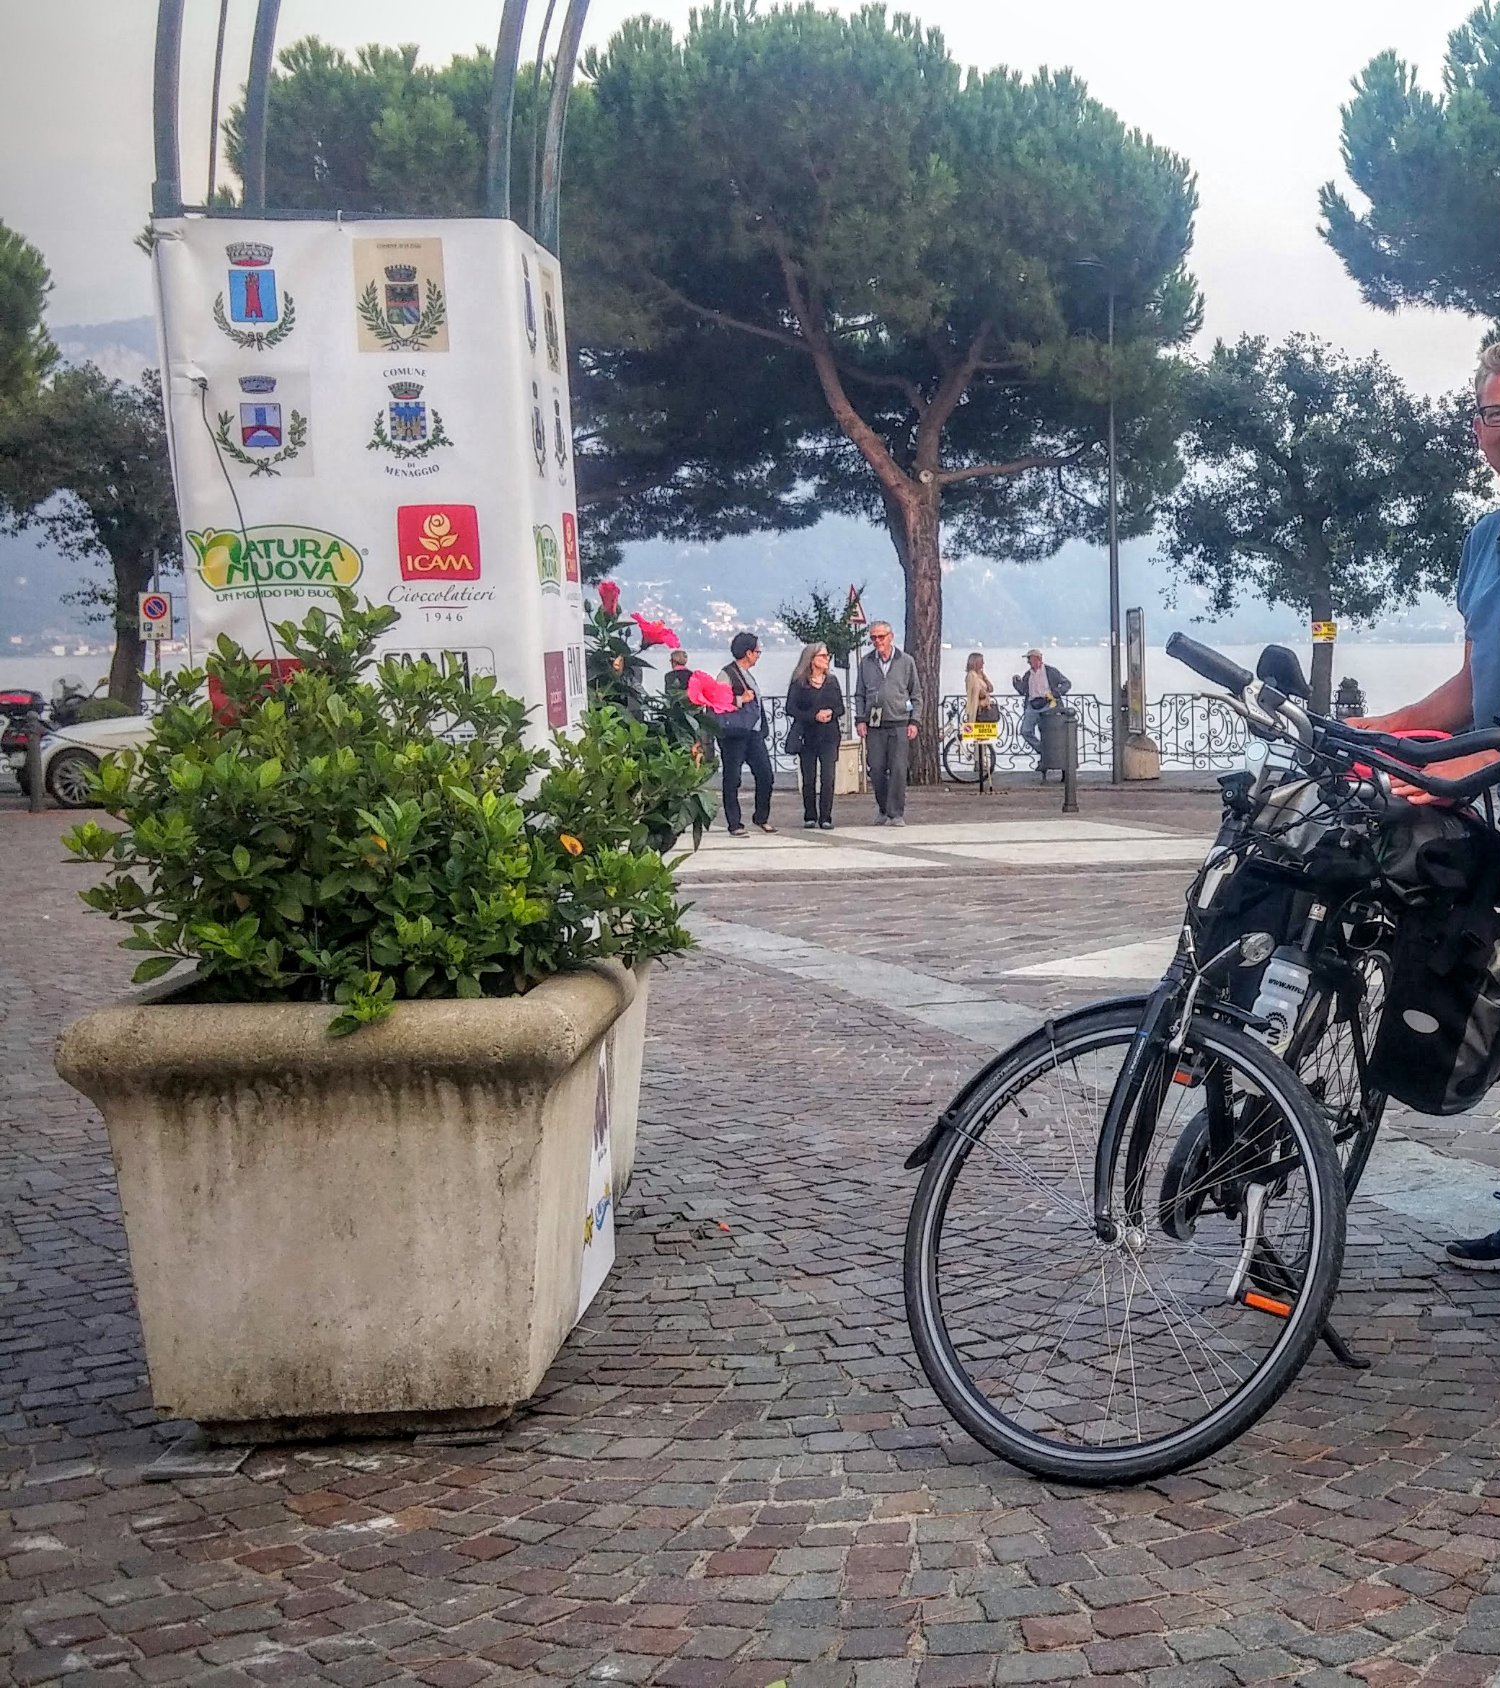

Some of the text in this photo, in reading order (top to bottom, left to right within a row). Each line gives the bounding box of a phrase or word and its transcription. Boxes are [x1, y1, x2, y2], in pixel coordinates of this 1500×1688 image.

[382, 368, 428, 377] COMUNE
[384, 464, 440, 478] MENAGGIO
[406, 554, 474, 571] ICAM
[226, 560, 338, 584] NUOVA
[216, 587, 336, 601] UN MONDO PIÙ BUO
[387, 585, 496, 603] Cioccolatieri
[425, 612, 463, 622] 1946
